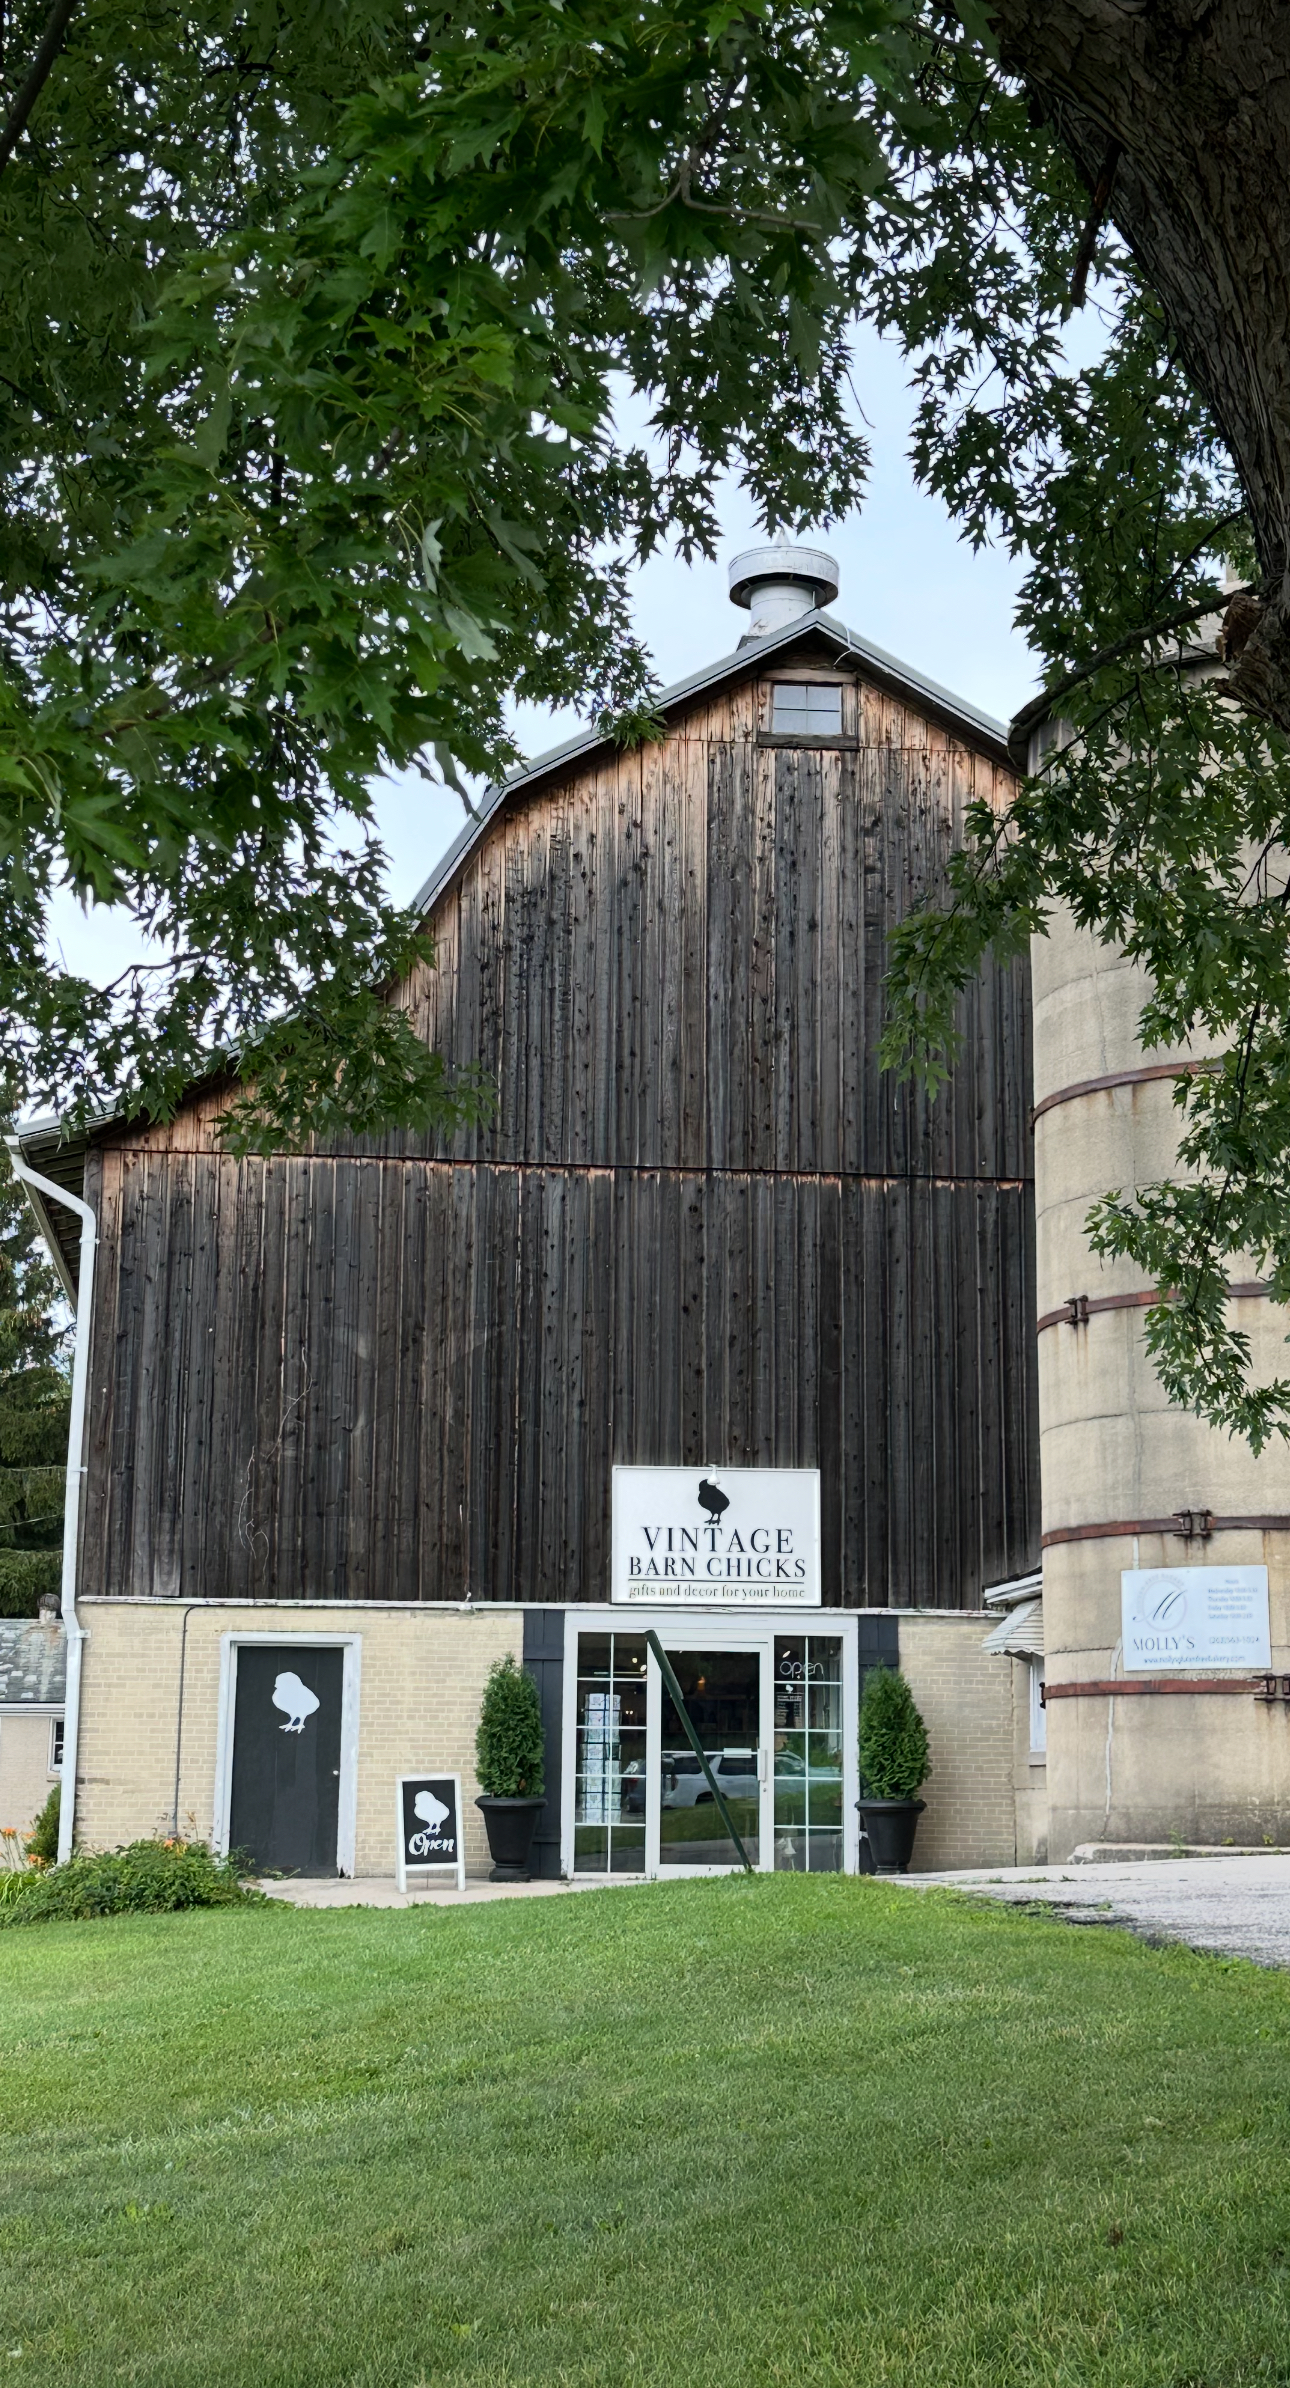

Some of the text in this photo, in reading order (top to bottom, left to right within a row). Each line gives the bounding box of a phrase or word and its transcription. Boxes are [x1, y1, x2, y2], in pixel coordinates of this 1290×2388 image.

[640, 1526, 794, 1554] VINTAGE
[628, 1556, 806, 1578] BARN CHICKS
[629, 1584, 805, 1600] gifts and decor for your home
[1133, 1635, 1195, 1651] MOLLY'S
[779, 1661, 825, 1680] open
[408, 1832, 455, 1857] Open
